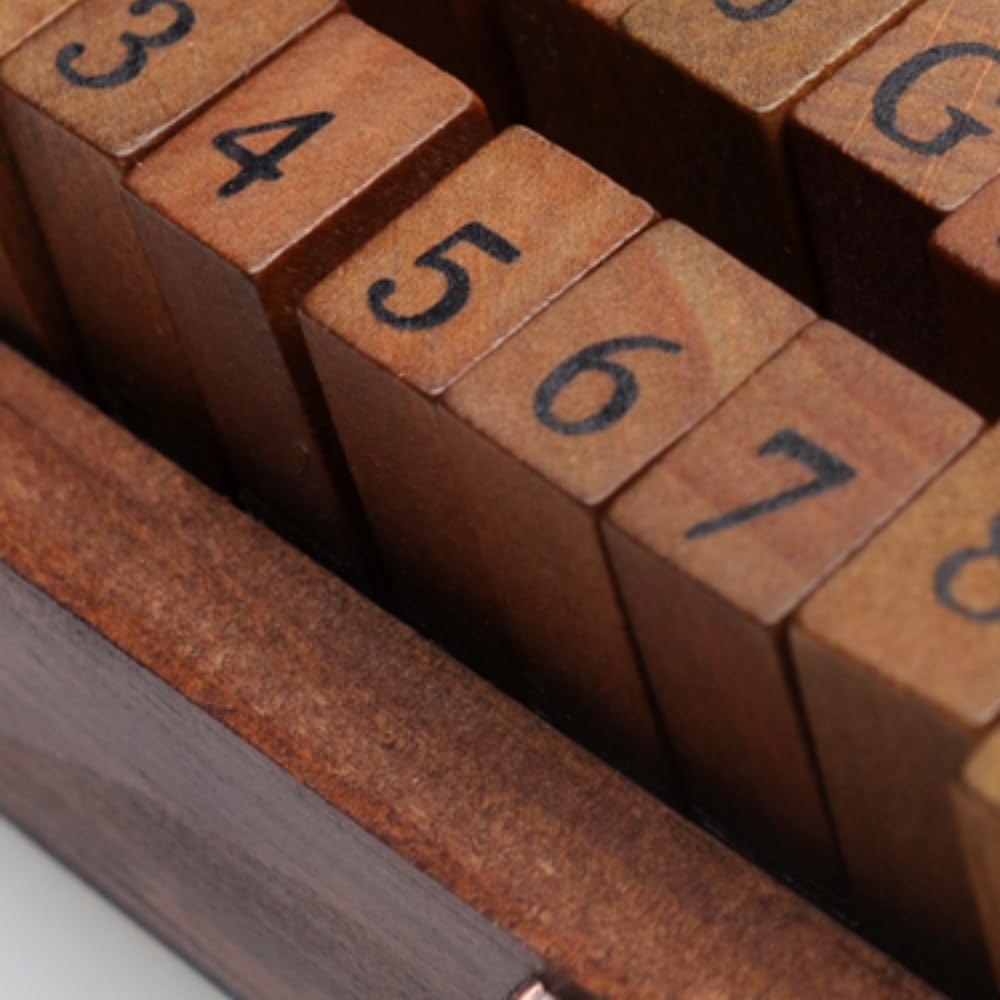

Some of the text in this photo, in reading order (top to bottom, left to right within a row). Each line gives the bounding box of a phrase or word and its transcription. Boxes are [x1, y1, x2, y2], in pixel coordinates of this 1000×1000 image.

[213, 112, 335, 199] 4
[367, 222, 521, 331] 5
[534, 336, 682, 435] 6
[686, 429, 856, 539] 7
